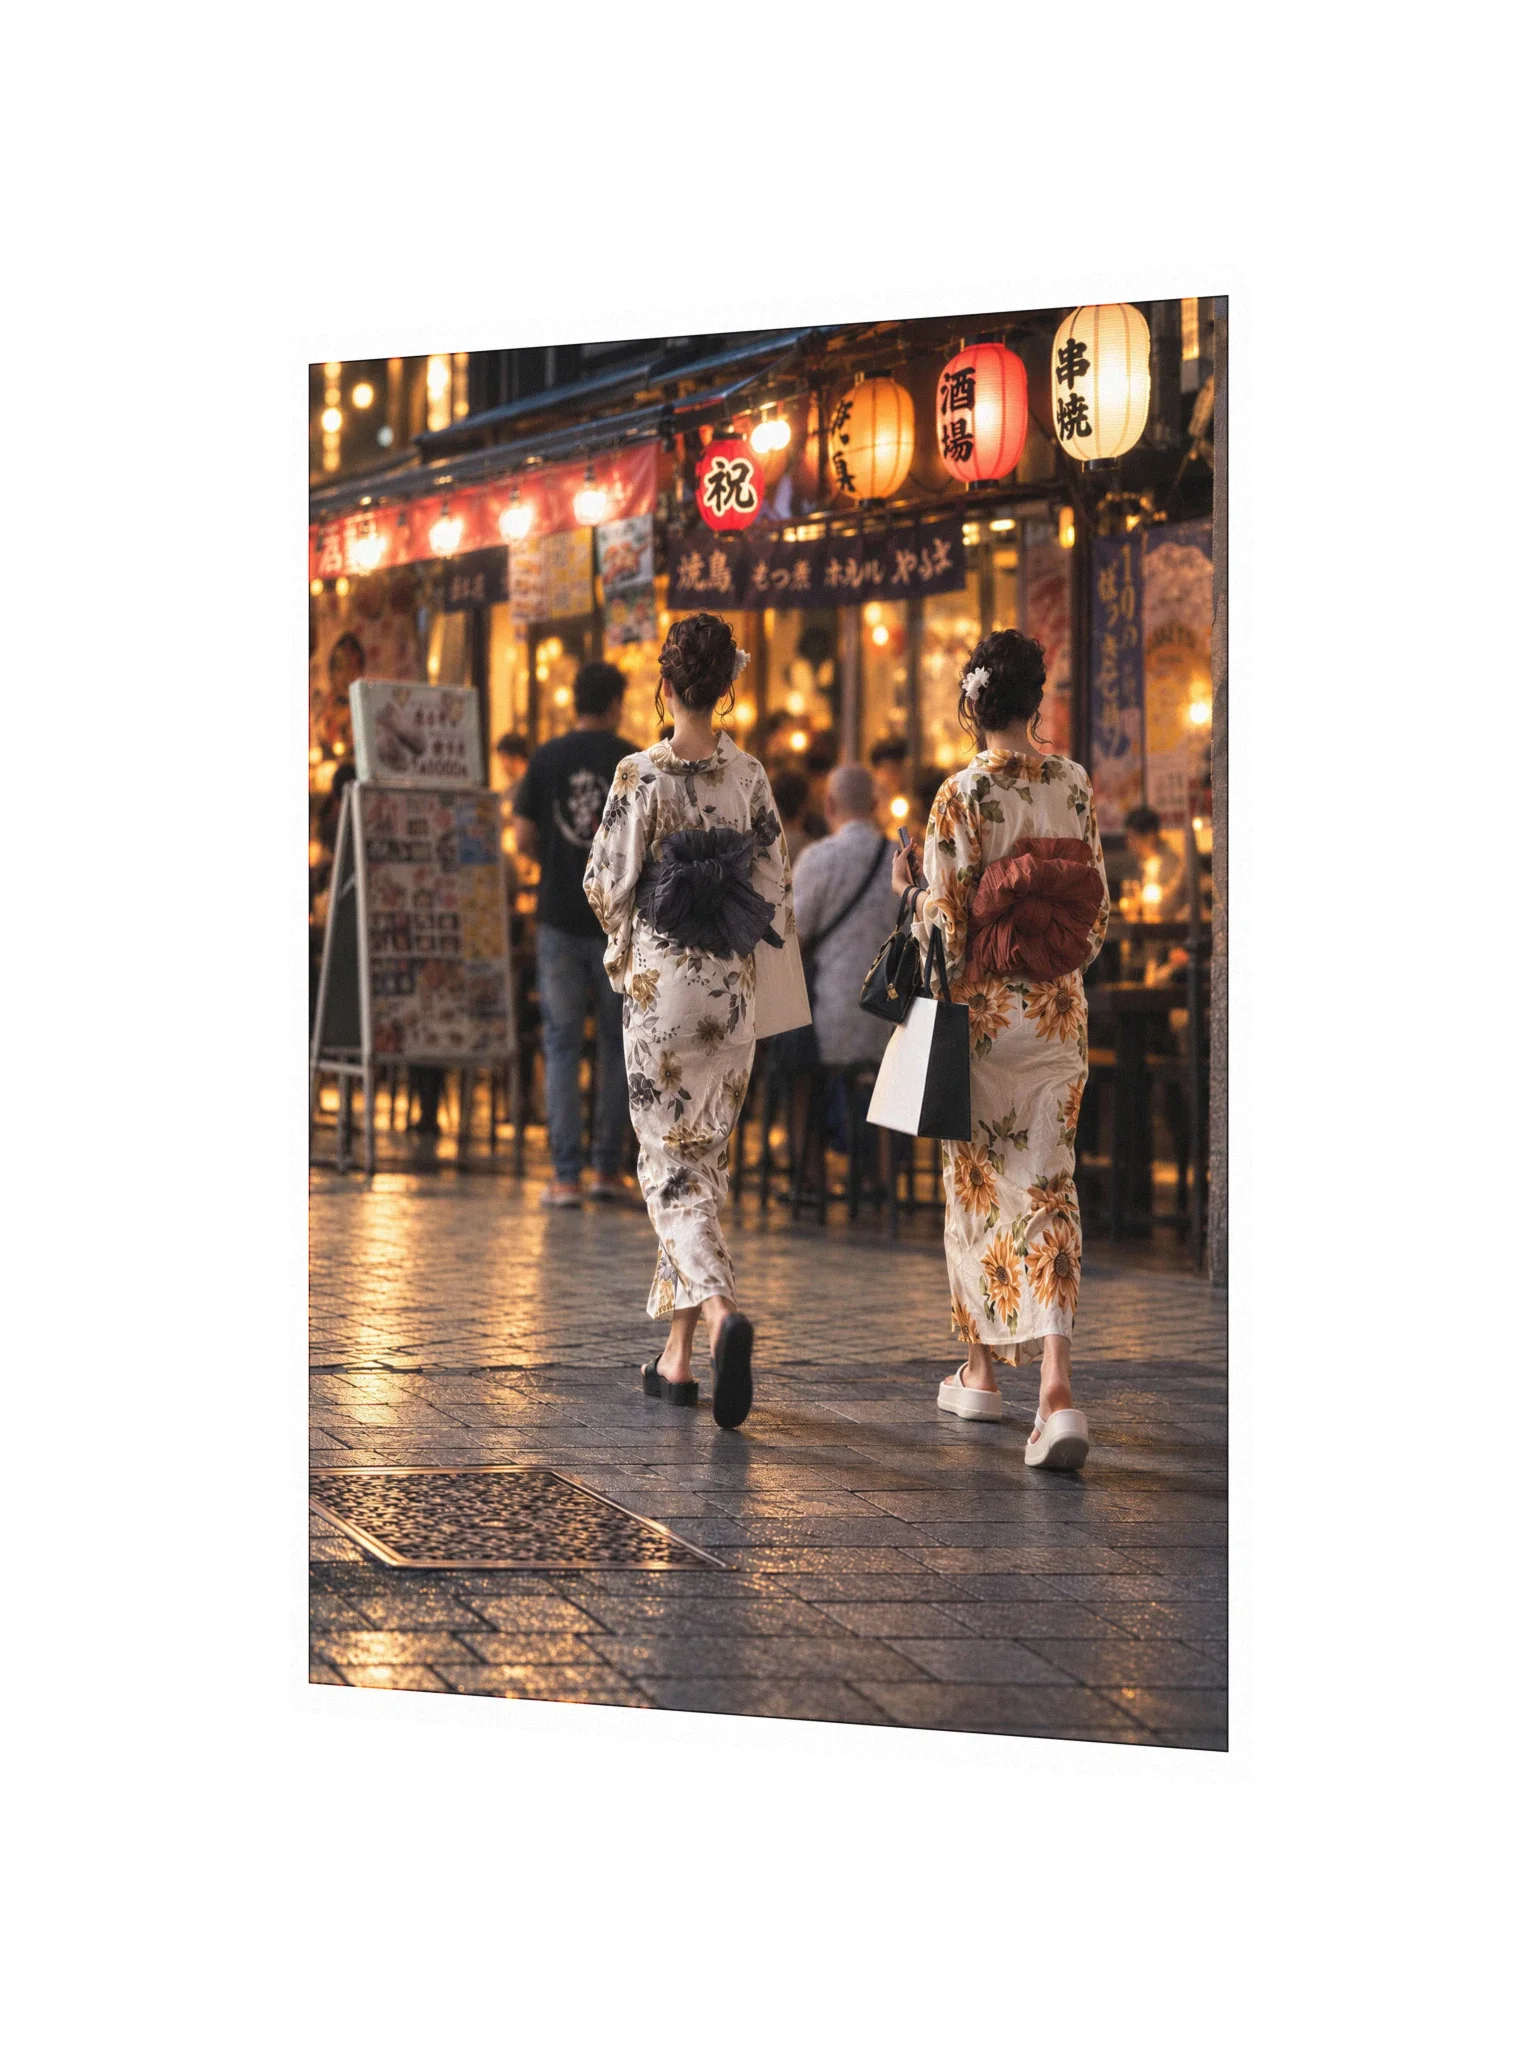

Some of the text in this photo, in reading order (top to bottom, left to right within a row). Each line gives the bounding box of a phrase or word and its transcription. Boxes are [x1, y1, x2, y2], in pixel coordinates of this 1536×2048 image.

[940, 366, 976, 463] 酒場
[1055, 338, 1092, 442] 串焼
[705, 458, 757, 515] 祝
[676, 549, 733, 594] 焼鳥
